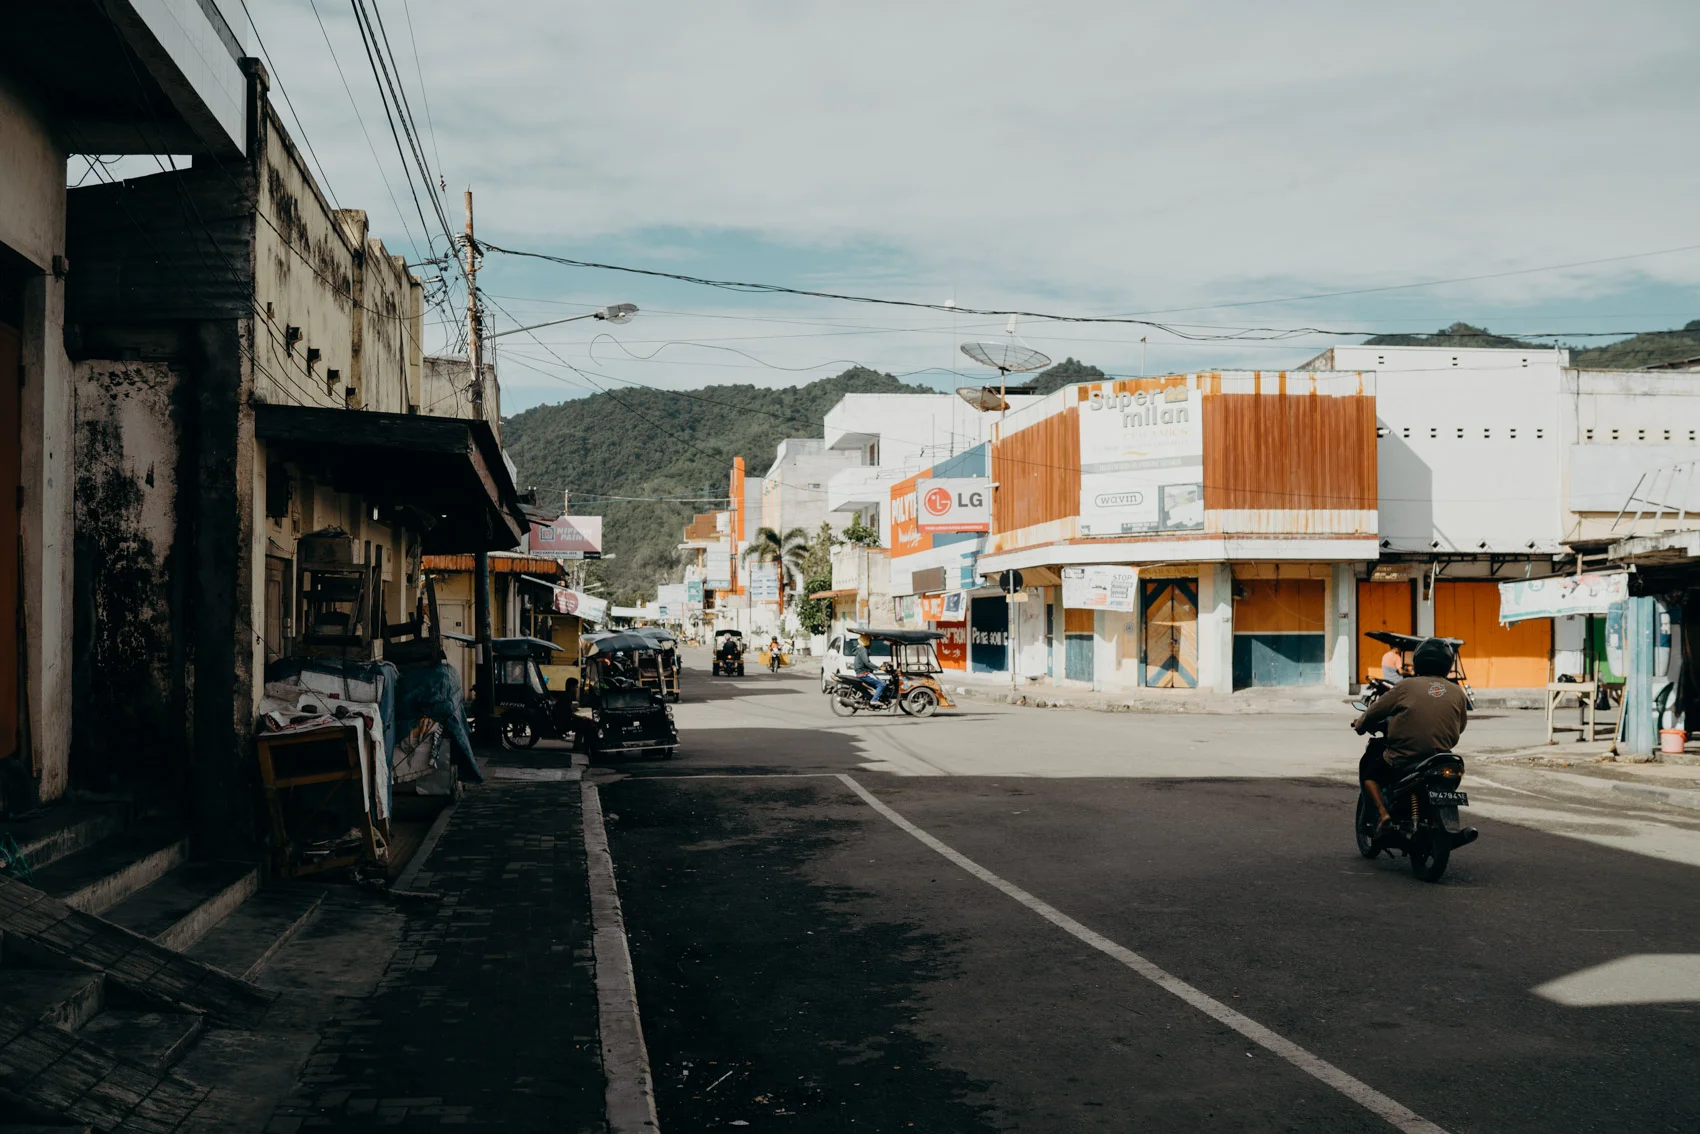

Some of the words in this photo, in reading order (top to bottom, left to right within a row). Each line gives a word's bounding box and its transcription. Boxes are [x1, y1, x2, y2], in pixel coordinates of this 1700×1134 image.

[1090, 388, 1161, 412] Super
[1123, 405, 1189, 428] milan
[957, 492, 983, 508] LG
[1100, 494, 1138, 505] wavin
[1112, 573, 1133, 582] STOP
